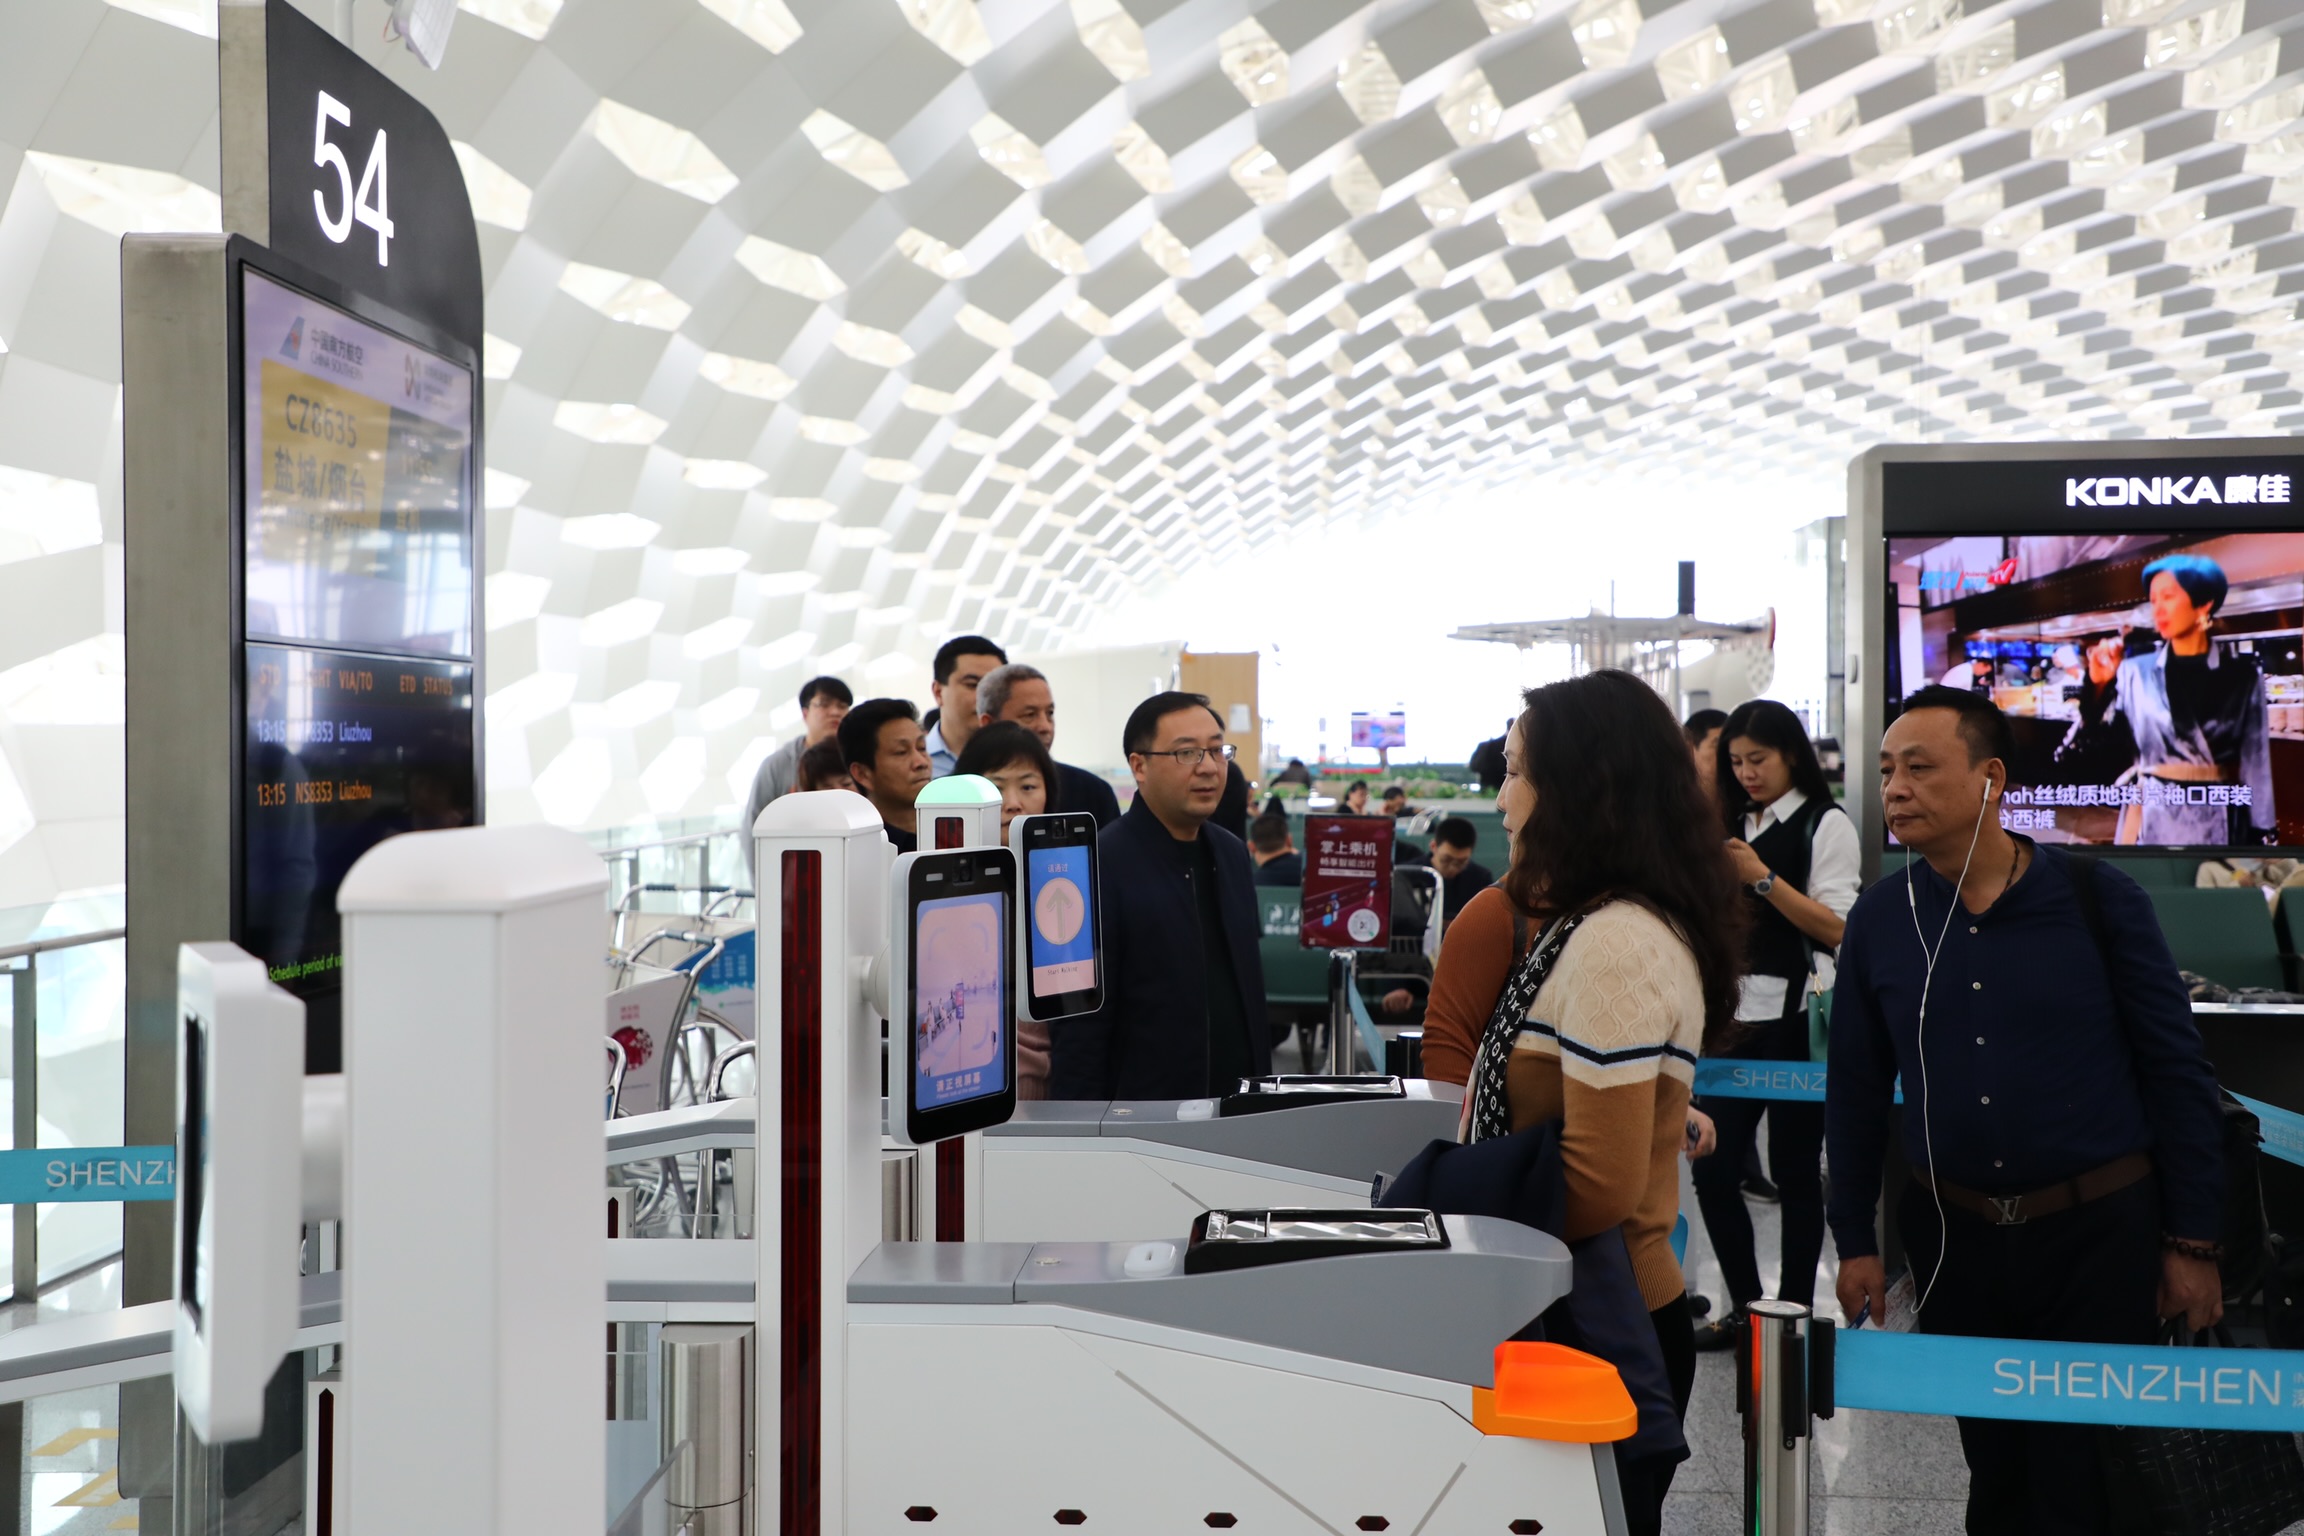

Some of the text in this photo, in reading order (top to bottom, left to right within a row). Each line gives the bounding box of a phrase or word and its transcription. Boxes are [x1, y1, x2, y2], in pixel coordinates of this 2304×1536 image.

[313, 90, 394, 267] 54
[286, 393, 357, 448] CZ8635
[2066, 476, 2223, 506] KONKA
[339, 670, 373, 695] VIA/TO
[400, 675, 416, 693] ETD
[423, 676, 453, 695] STATUS
[257, 719, 286, 743] 13:15
[339, 721, 372, 743] Liuzhou
[257, 779, 372, 806] 13:15 NS8353 Liuzhou
[1320, 840, 1378, 857] 掌上乘机
[1993, 1357, 2281, 1406] SHENZHEN
